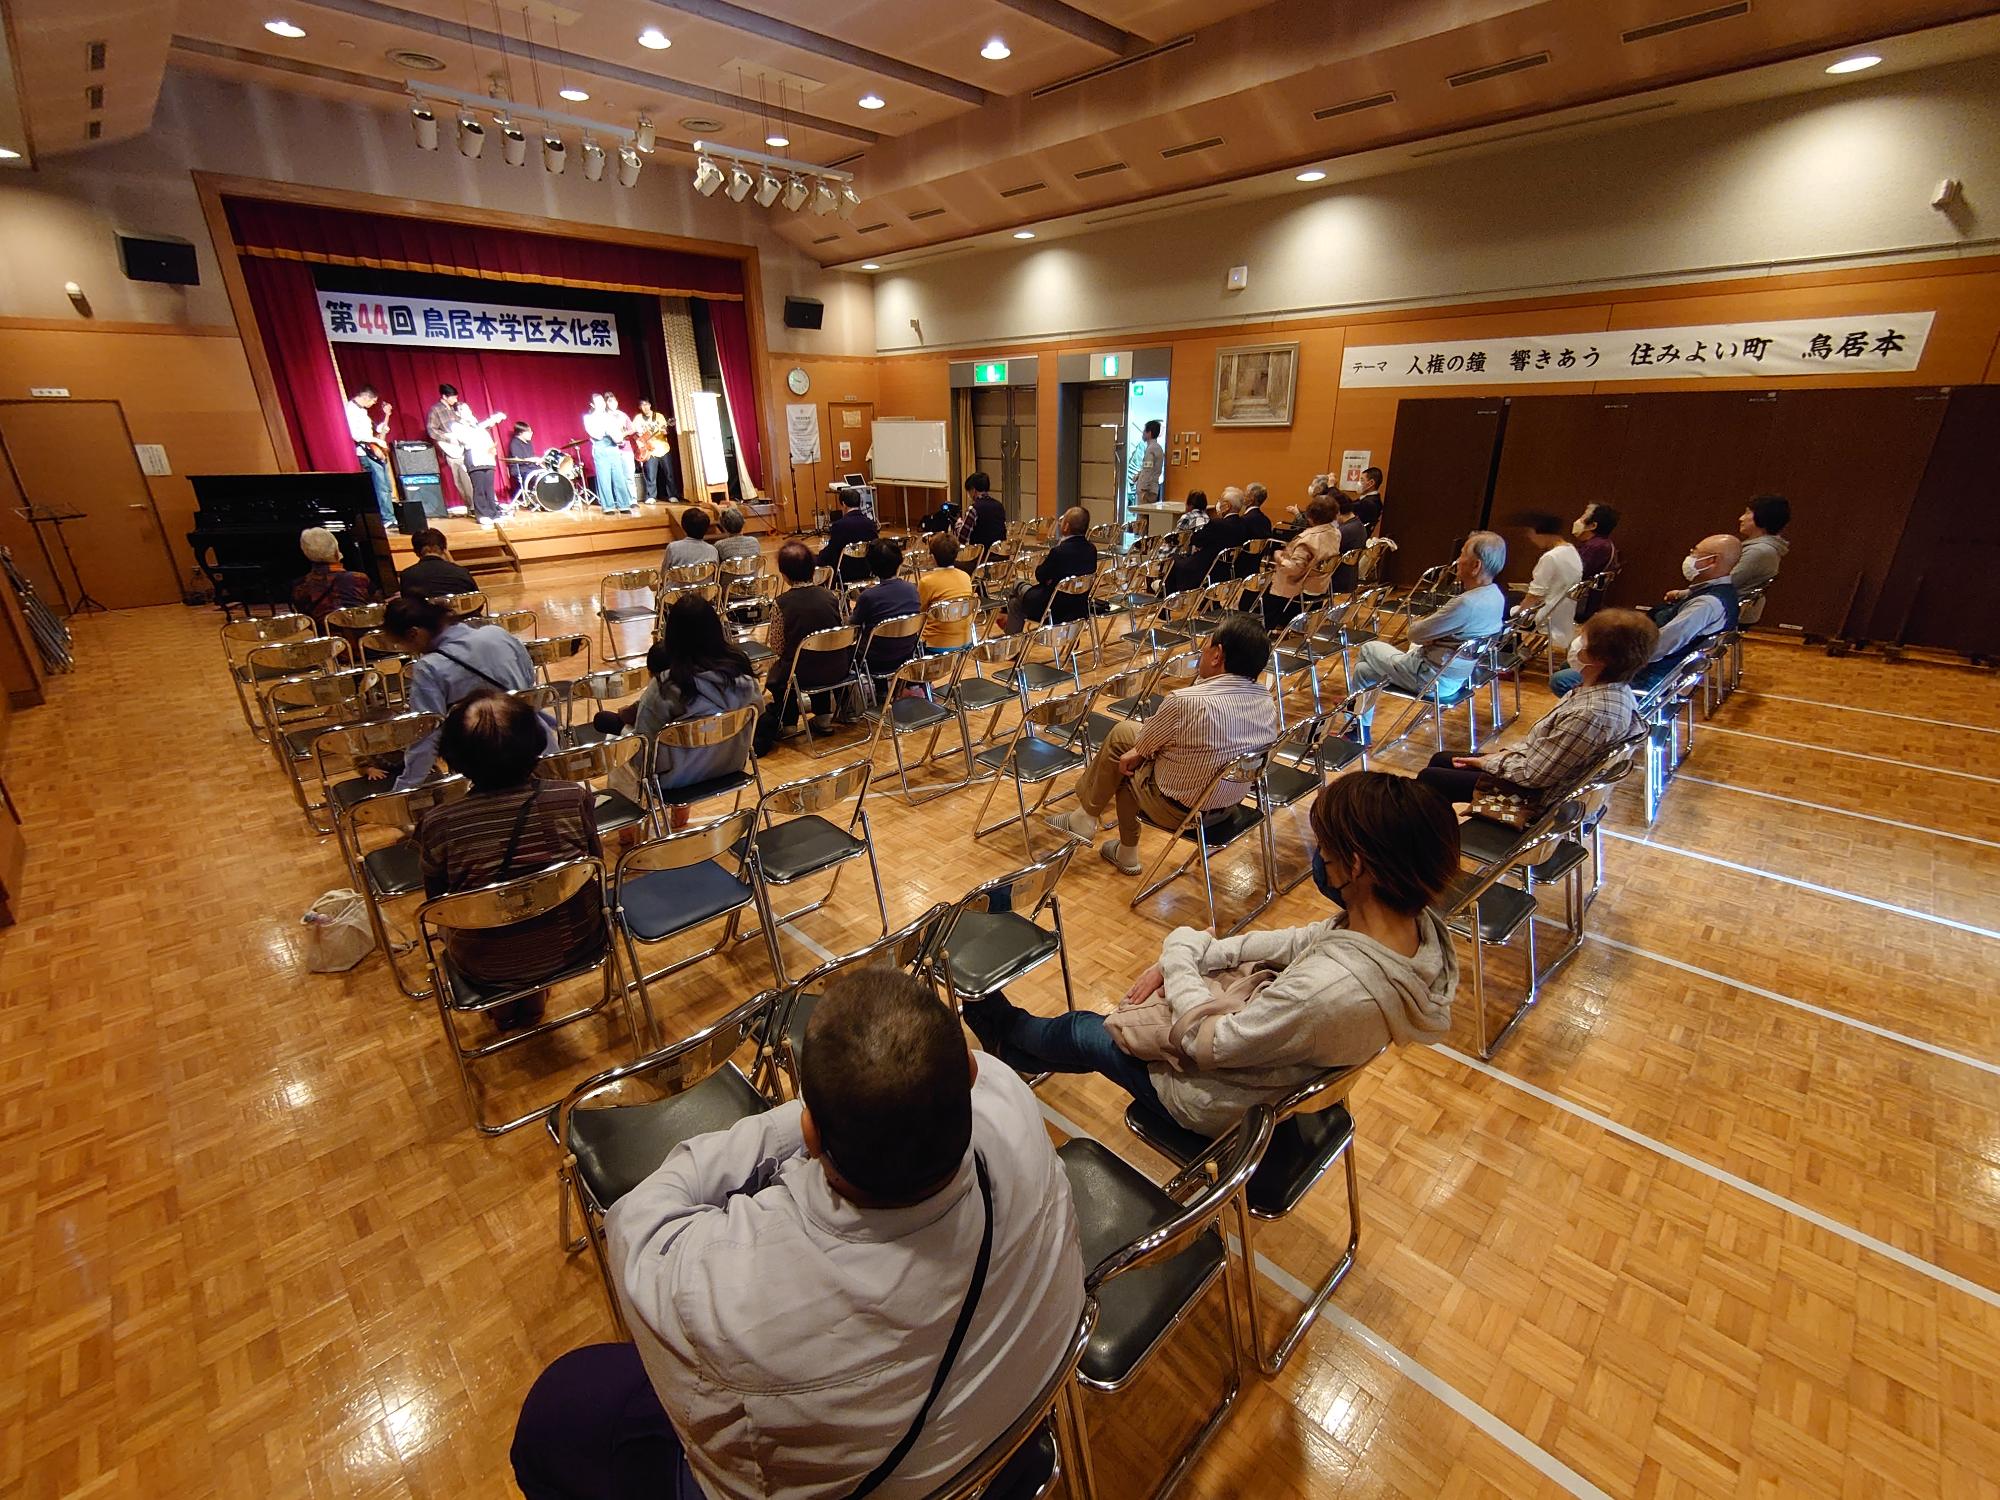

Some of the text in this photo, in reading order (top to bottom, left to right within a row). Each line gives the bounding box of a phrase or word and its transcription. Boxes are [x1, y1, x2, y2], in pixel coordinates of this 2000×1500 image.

[325, 299, 613, 348] 第44回 鳥居本学区文化祭
[1352, 328, 1906, 376] テーマ 人権の鐘 響きあう 住みよい町 鳥居本
